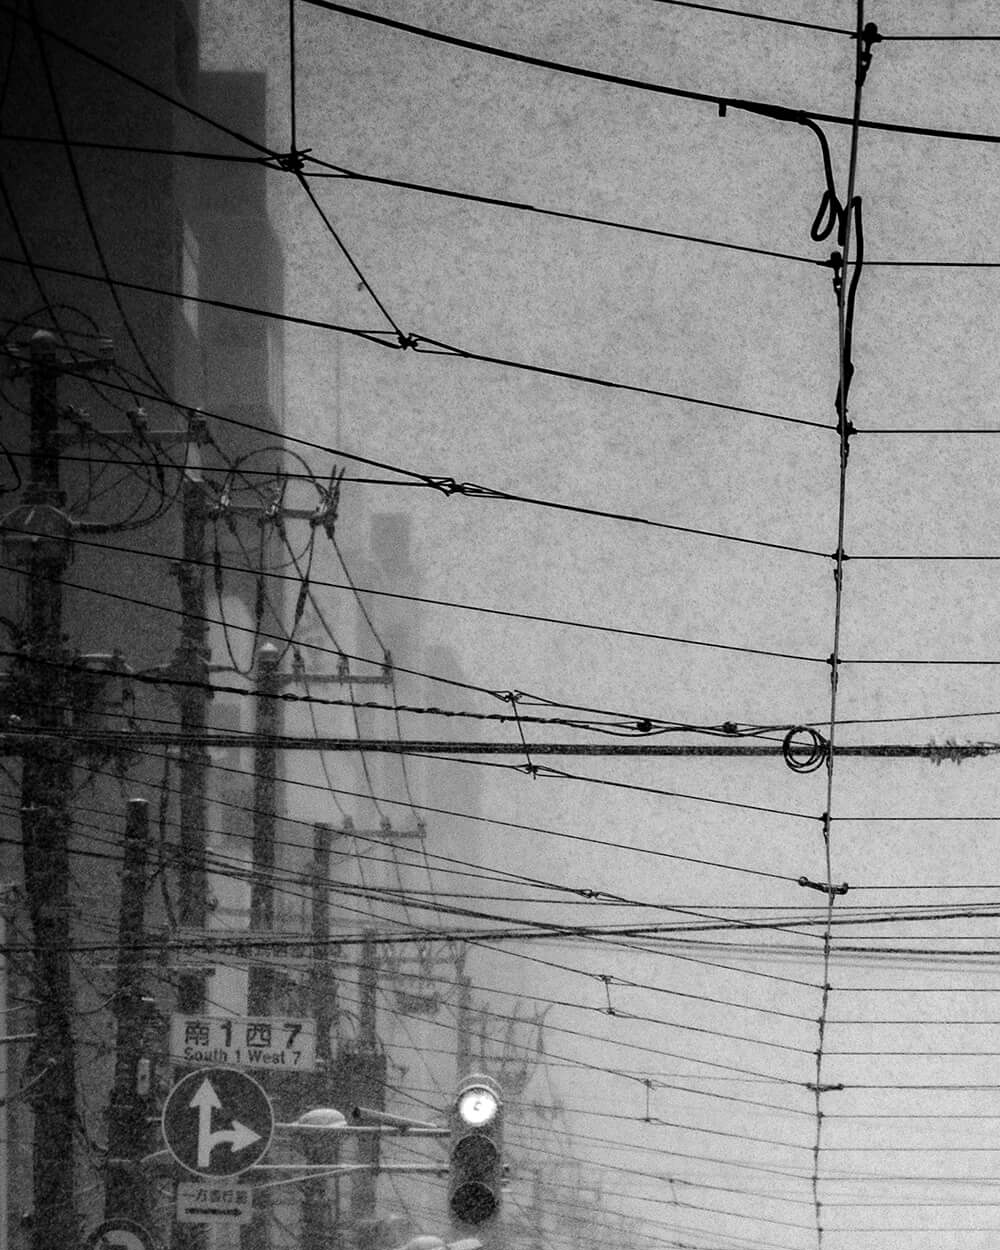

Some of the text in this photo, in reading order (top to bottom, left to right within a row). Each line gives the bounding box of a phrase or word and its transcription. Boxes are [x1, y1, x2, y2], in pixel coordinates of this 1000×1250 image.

[184, 1046, 302, 1065] South 1 West 7
